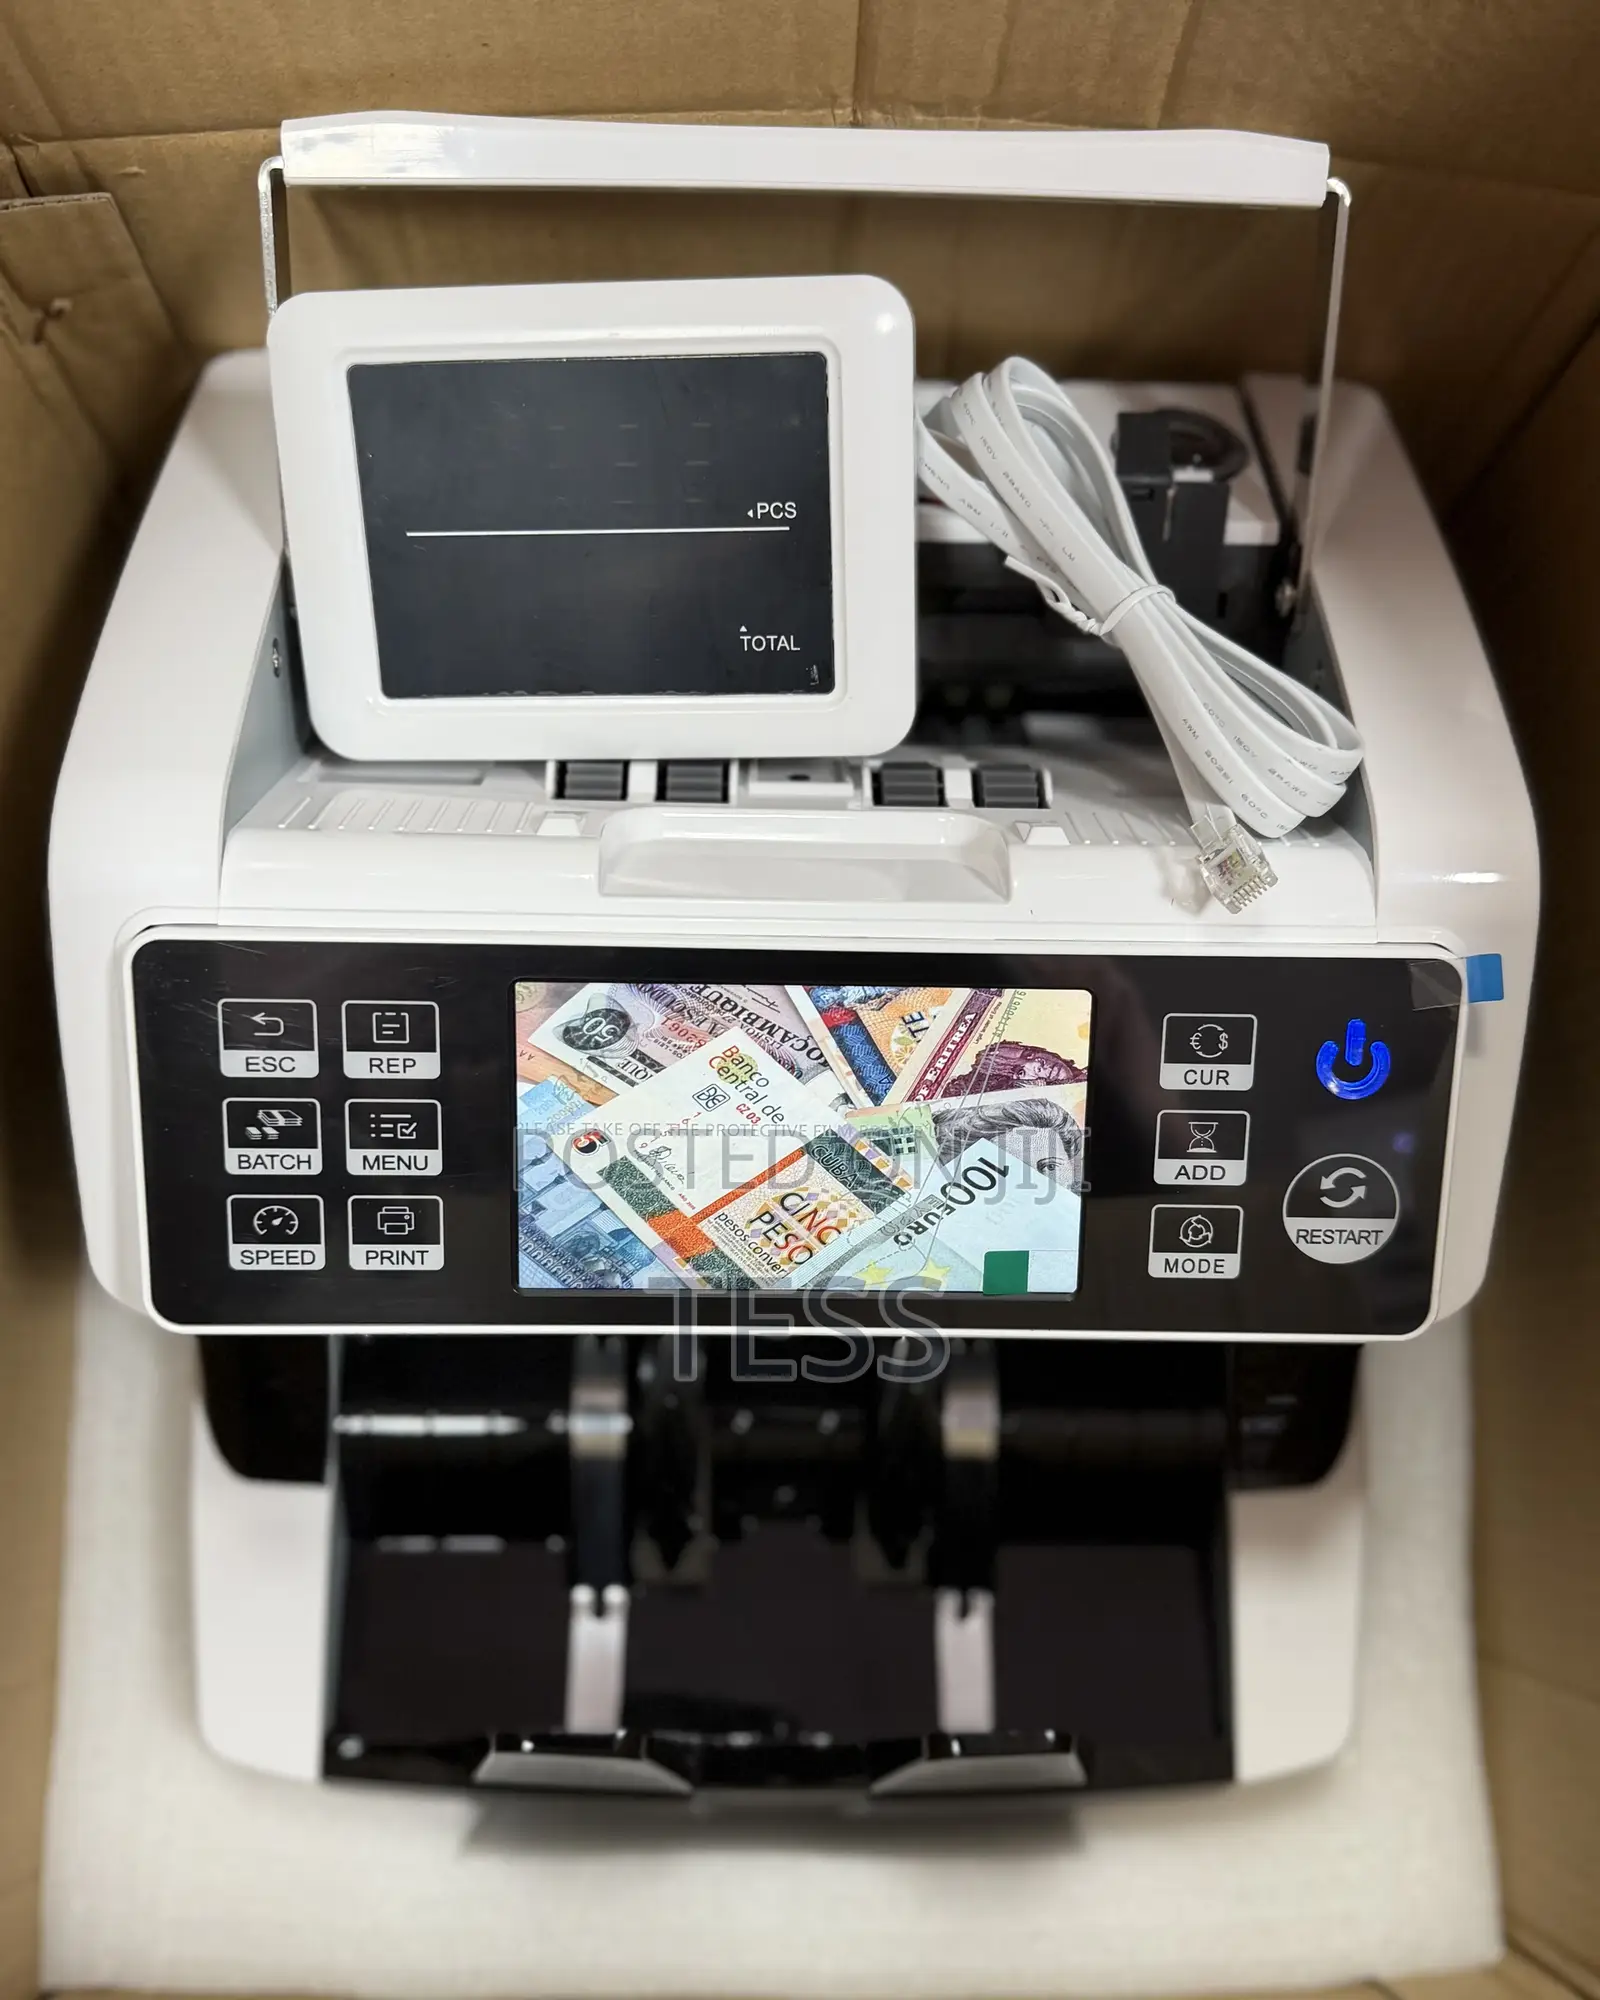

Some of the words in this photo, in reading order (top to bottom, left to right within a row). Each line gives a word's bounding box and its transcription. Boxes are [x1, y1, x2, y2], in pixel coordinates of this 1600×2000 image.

[757, 502, 797, 519] PCS
[740, 635, 800, 651] TOTAL
[1182, 718, 1199, 740] AWM
[582, 1016, 620, 1043] 50
[927, 1012, 978, 1083] ERITREA
[245, 1056, 296, 1073] ESC
[369, 1058, 417, 1074] REP
[721, 1045, 770, 1088] Banco
[1183, 1069, 1230, 1086] CUR
[708, 1055, 768, 1105] Central
[761, 1093, 785, 1124] de
[581, 1122, 628, 1137] TAKE
[629, 1122, 661, 1137] OFF
[705, 1123, 808, 1138] PROTECTIVE
[237, 1154, 312, 1170] BATCH
[362, 1155, 429, 1171] MENU
[811, 1144, 860, 1189] CUBA
[1174, 1165, 1226, 1180] ADD
[940, 1157, 1010, 1206] 100
[713, 1212, 750, 1242] pesos
[893, 1201, 957, 1247] EURO
[750, 1210, 814, 1265] PESO
[1295, 1228, 1384, 1245] RESTART
[240, 1249, 316, 1266] SPEED
[365, 1250, 429, 1266] PRINT
[1164, 1258, 1226, 1274] MODE
